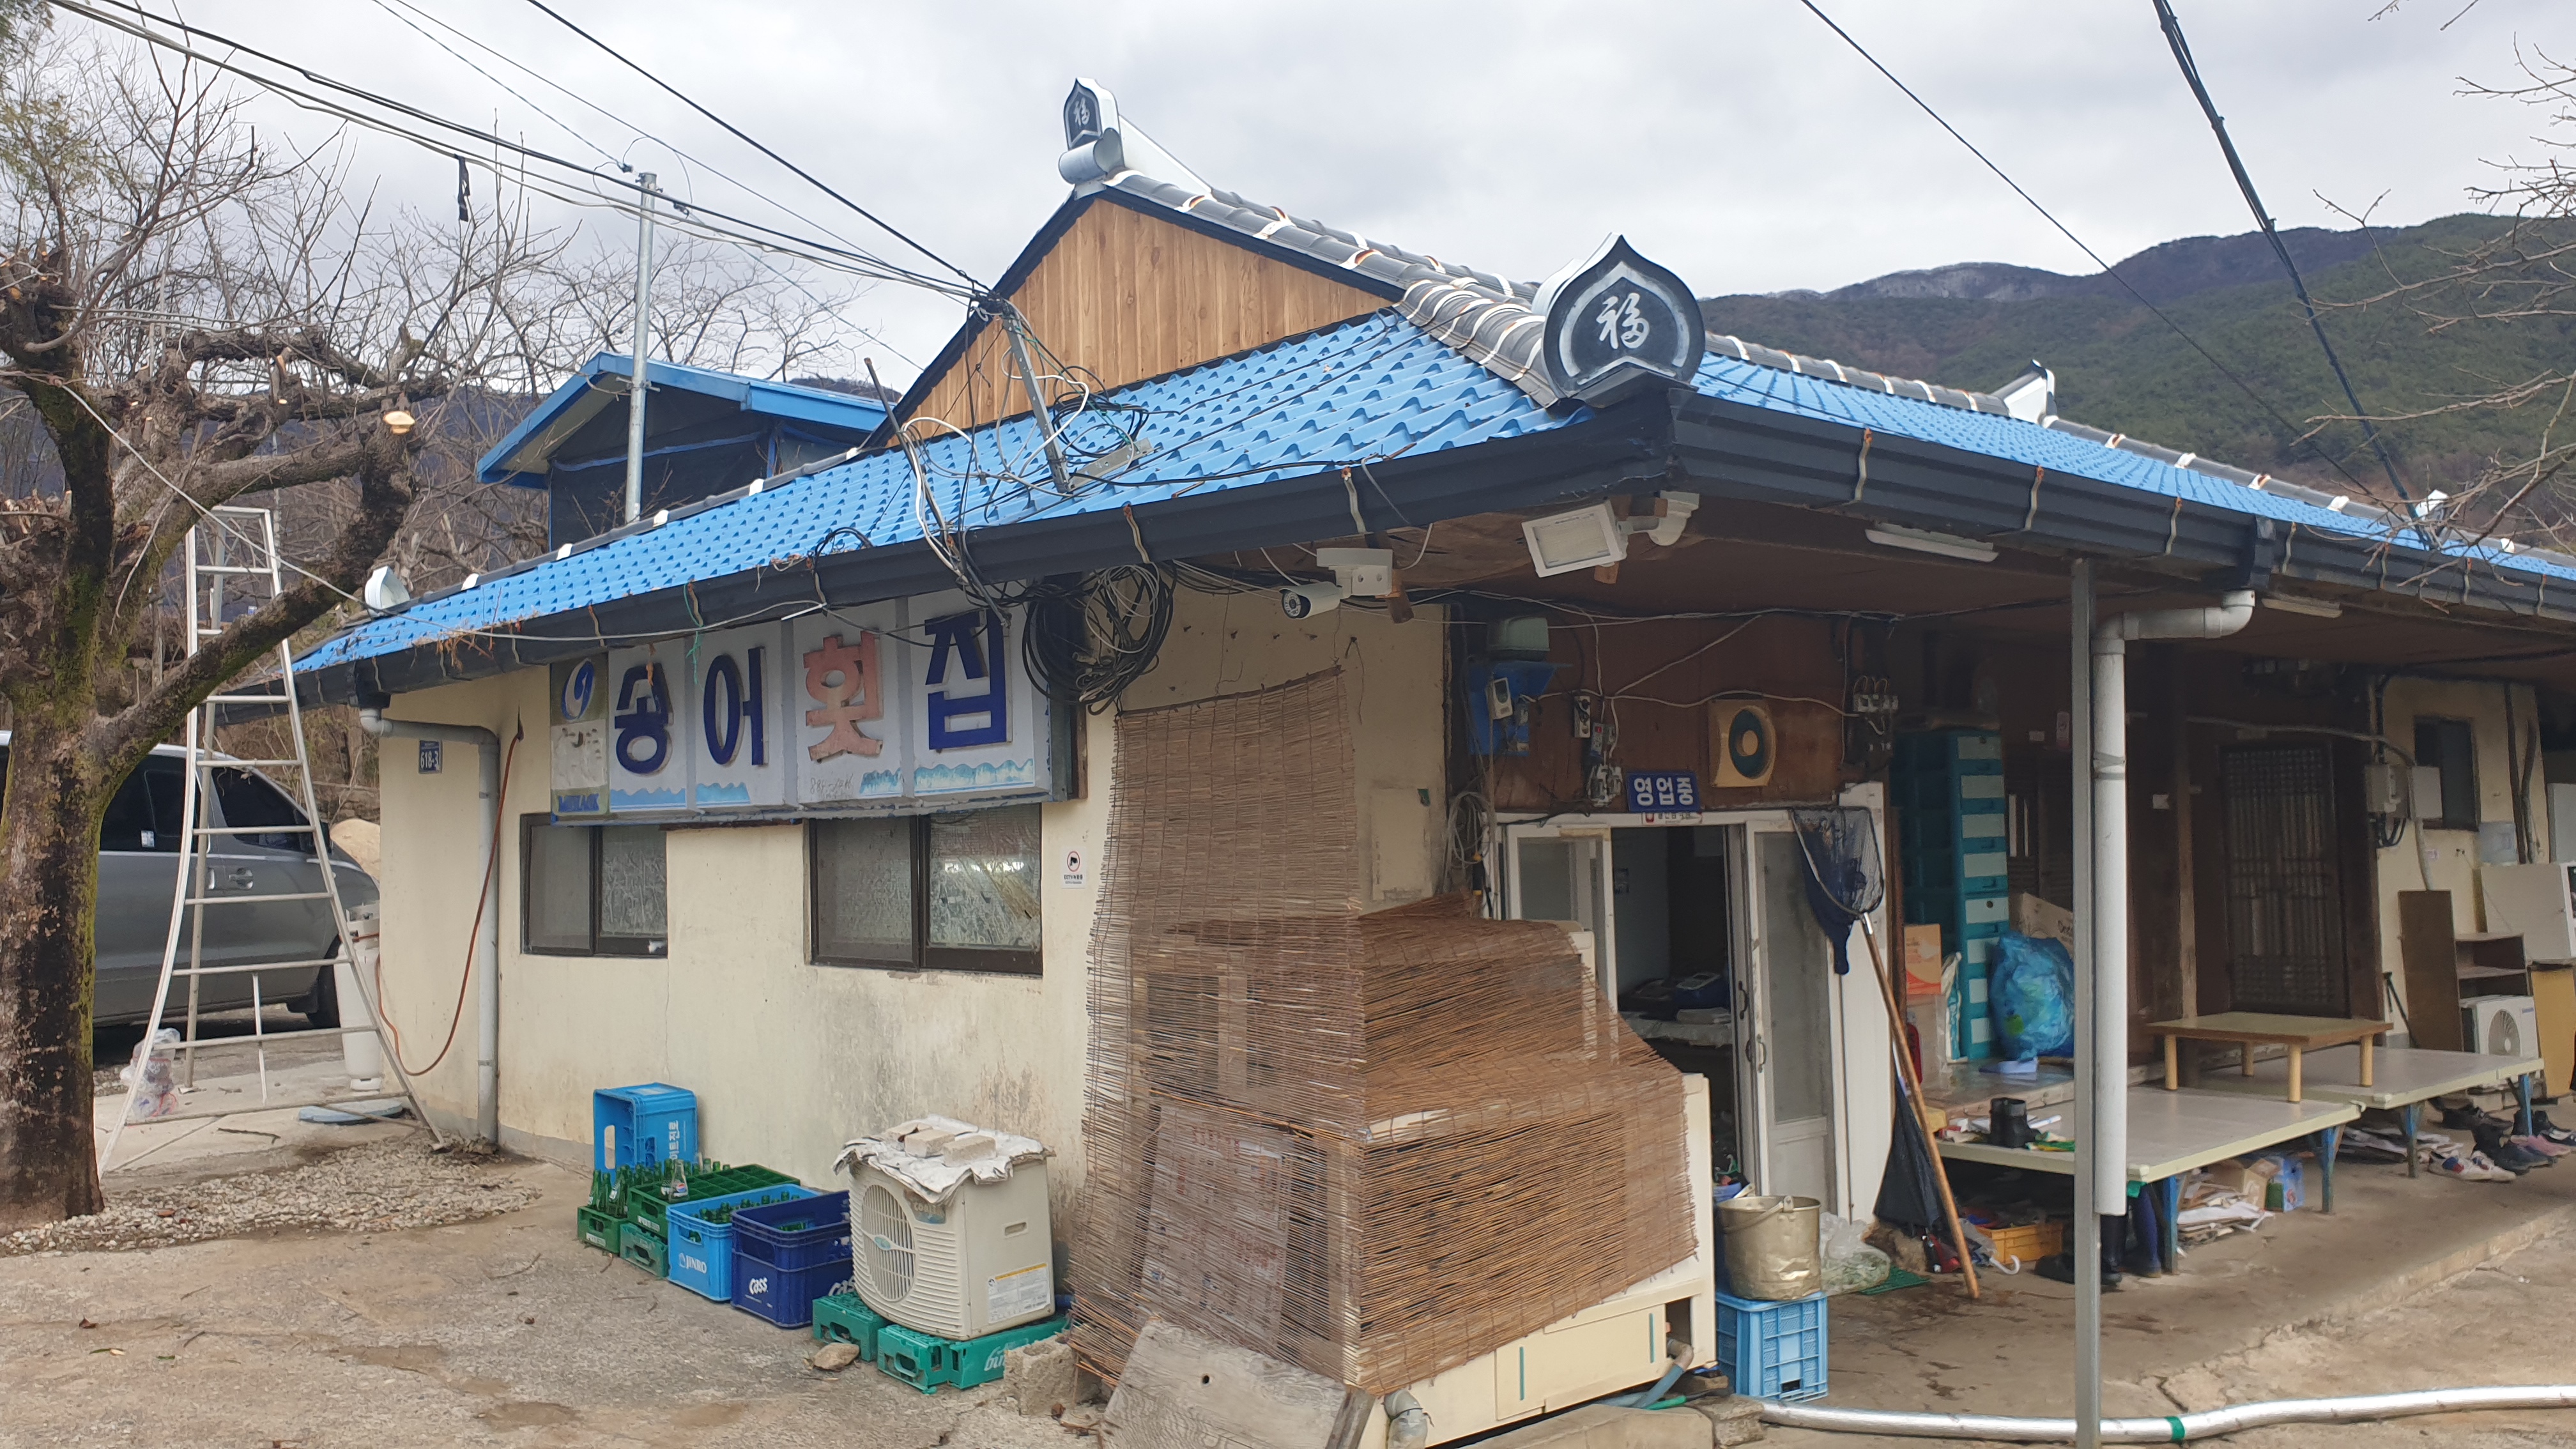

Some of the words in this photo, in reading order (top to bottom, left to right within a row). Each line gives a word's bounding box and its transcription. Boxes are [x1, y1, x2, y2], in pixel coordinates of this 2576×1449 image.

[1597, 292, 1650, 349] 福
[615, 607, 1009, 774] 송어횟집
[1634, 777, 1693, 806] 영업중
[668, 1120, 680, 1160] 이트진로
[686, 1255, 707, 1274] JINRO
